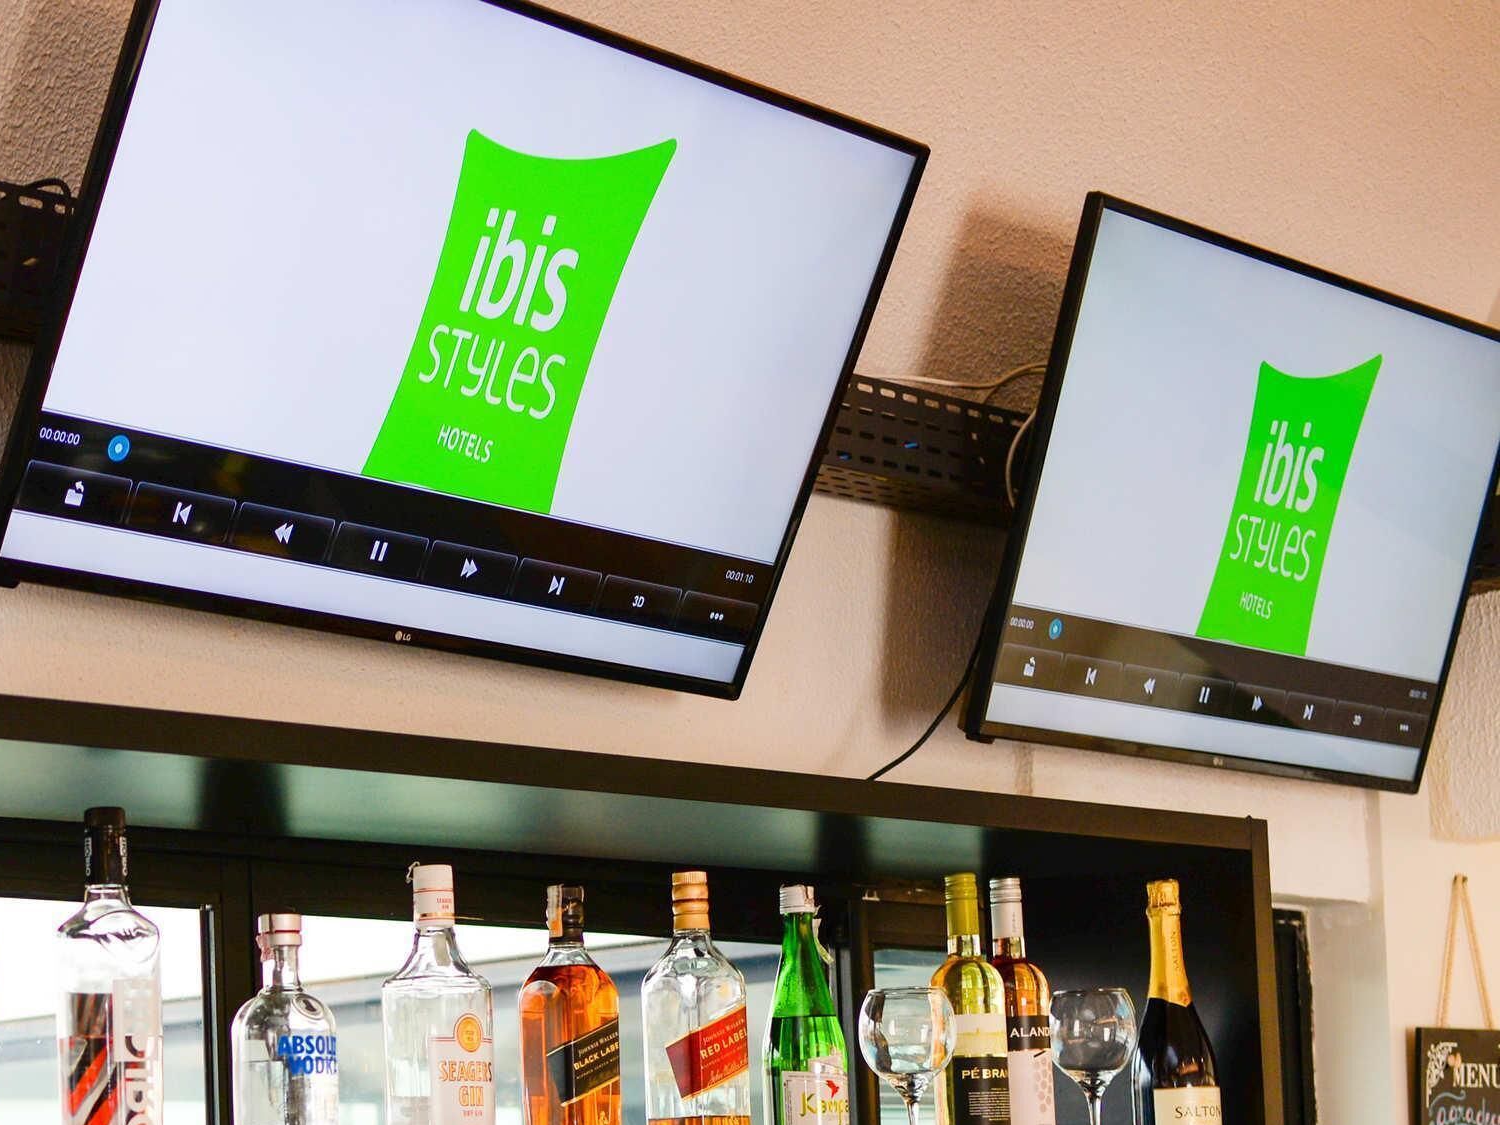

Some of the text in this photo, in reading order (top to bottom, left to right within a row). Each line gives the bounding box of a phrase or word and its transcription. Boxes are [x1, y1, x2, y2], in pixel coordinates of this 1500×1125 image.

[458, 207, 580, 332] ibis
[436, 423, 494, 463] HOTELS
[1253, 419, 1324, 513] ibis
[631, 594, 646, 609] 3D
[1239, 591, 1274, 620] HOTELS
[573, 1052, 601, 1071] BLACK
[700, 1043, 721, 1060] RED
[438, 1060, 493, 1083] SEAGERS
[961, 1066, 981, 1080] PÉ
[458, 1086, 485, 1107] GIN
